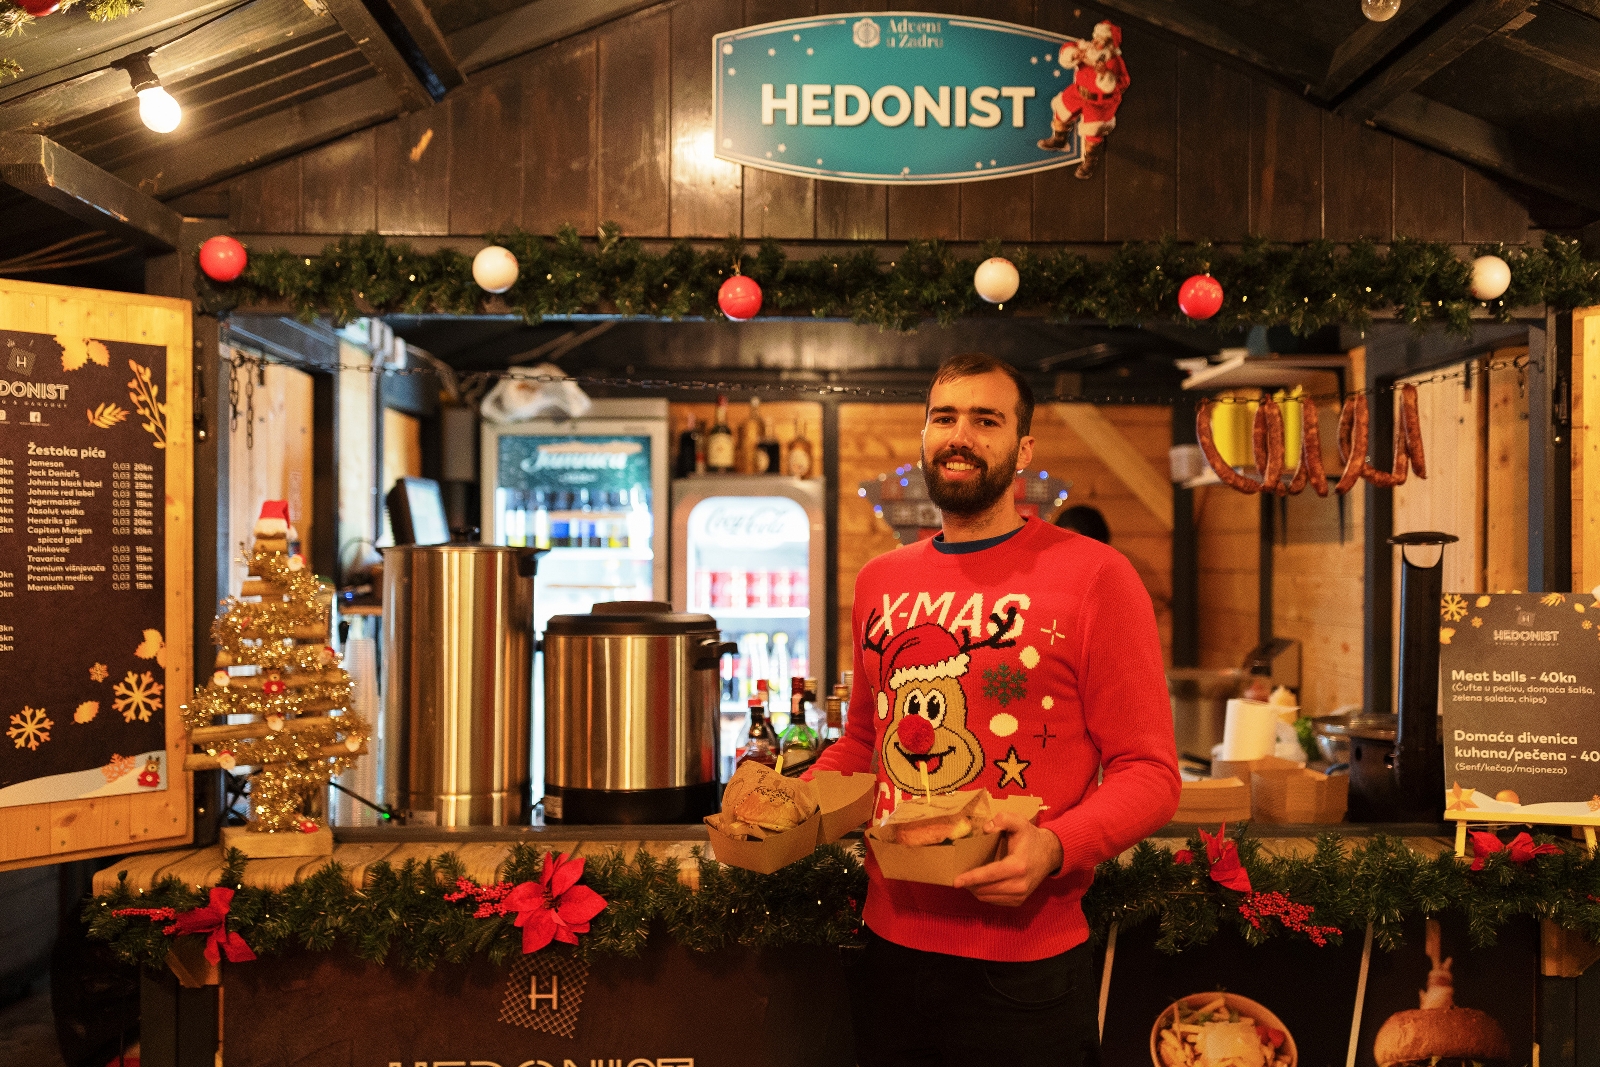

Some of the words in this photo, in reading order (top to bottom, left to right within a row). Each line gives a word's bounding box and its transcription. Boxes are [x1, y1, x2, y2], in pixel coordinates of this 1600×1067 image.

[761, 83, 1036, 128] HEDONIST
[16, 355, 27, 368] H
[27, 441, 79, 457] Žestoka
[80, 446, 107, 460] pića
[27, 459, 64, 468] Jameson
[27, 469, 47, 477] Jack
[47, 469, 80, 478] Daniel's
[27, 478, 60, 487] Johnnie
[60, 479, 82, 488] black
[82, 480, 103, 488] label
[27, 488, 60, 497] Johnnie
[60, 489, 75, 497] red
[75, 489, 96, 498] label
[27, 507, 59, 515] Absolut
[60, 507, 85, 516] vodka
[27, 516, 63, 525] Hendriks
[64, 517, 78, 526] gin
[61, 526, 93, 535] Morgan
[37, 536, 63, 545] spiced
[64, 536, 83, 545] gold
[27, 545, 70, 553] Pelinkovac
[27, 555, 66, 563] Travarica
[27, 564, 64, 573] Premium
[27, 573, 64, 582] Premium
[27, 583, 75, 591] Maraschino
[868, 591, 1032, 640] X-MAS
[1493, 629, 1560, 642] HEDONIST
[1451, 669, 1490, 682] Meat
[1492, 670, 1527, 683] balls
[1539, 671, 1577, 684] 40kn
[1527, 684, 1566, 695] domaća
[1452, 693, 1483, 702] zelena
[1484, 694, 1517, 704] salata,
[1518, 695, 1547, 705] chips)
[1454, 729, 1514, 743] Domaća
[1517, 731, 1578, 745] divenica
[1454, 746, 1567, 763] kuhana/pečena
[1455, 762, 1568, 776] (Senf/kečap/majoneza)
[527, 975, 558, 1011] H
